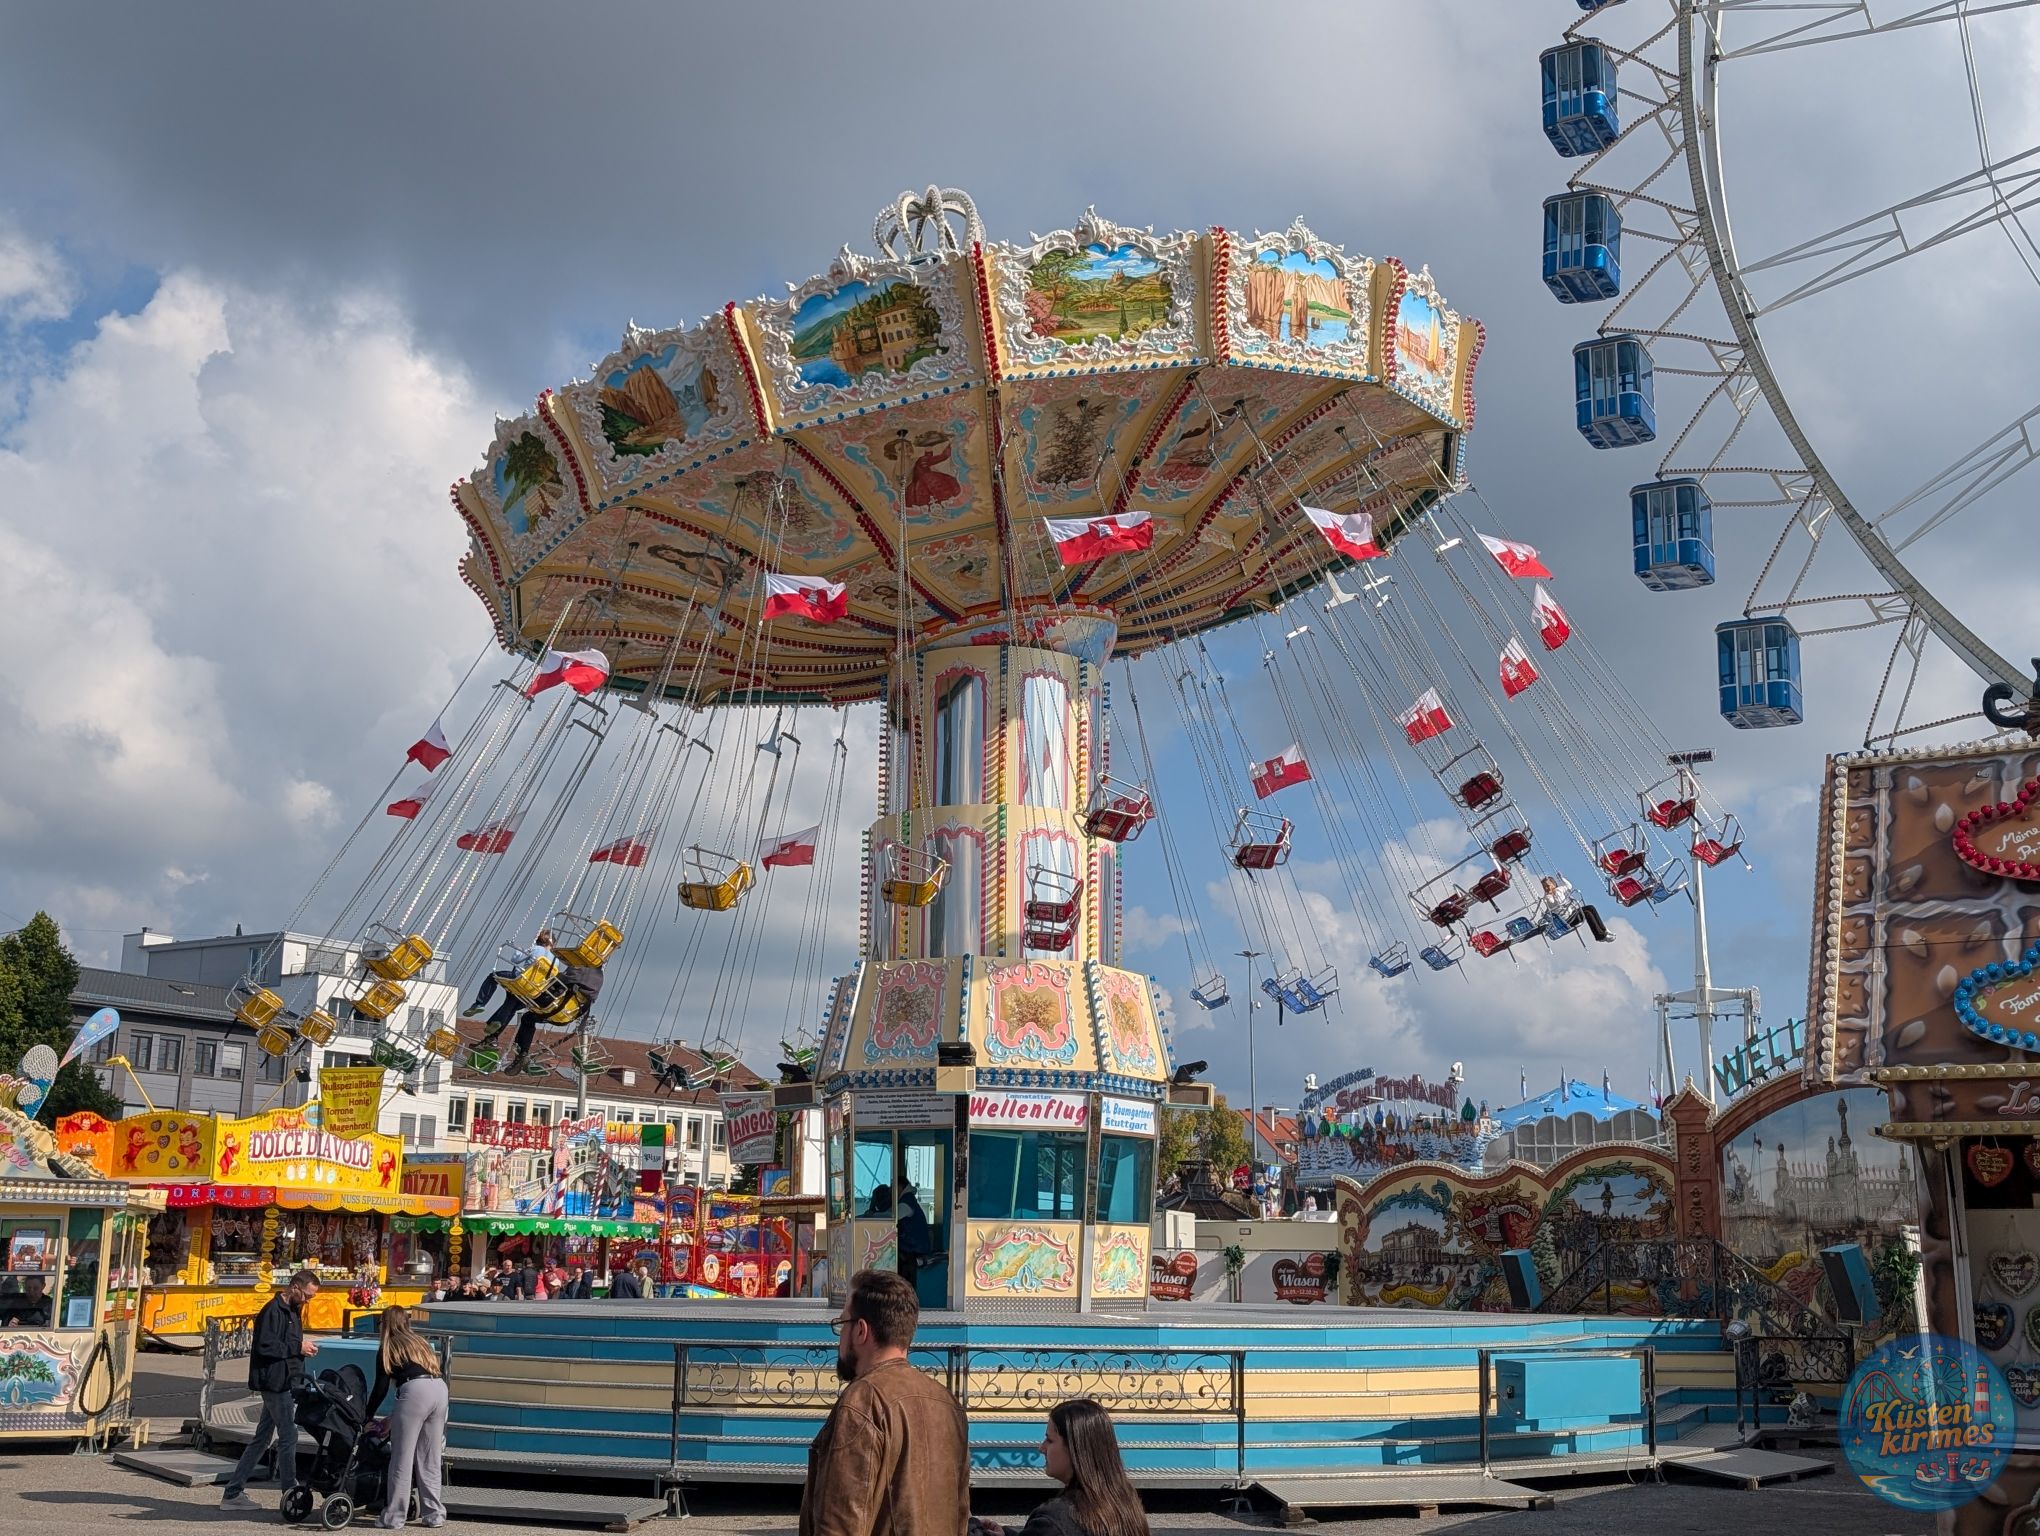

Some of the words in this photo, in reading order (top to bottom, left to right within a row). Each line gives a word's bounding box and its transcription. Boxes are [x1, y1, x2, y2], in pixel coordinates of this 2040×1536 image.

[1996, 827, 2040, 852] Meine
[1999, 987, 2040, 1014] Fam
[1712, 1017, 1805, 1097] WELL
[348, 1096, 372, 1106] Honig!
[325, 1107, 354, 1116] Torrone
[969, 1096, 1088, 1126] Wellenflug
[1112, 1102, 1154, 1121] Baumgartner
[329, 1121, 372, 1132] Magenbrot!
[1104, 1118, 1148, 1131] Stuttgart
[251, 1132, 303, 1159] DOLCE
[307, 1132, 370, 1168] DIAVOLO
[403, 1173, 449, 1197] PIZZA
[173, 1187, 269, 1200] ORRONE
[341, 1194, 361, 1204] NUSS
[394, 1219, 415, 1230] Pizza
[490, 1221, 515, 1230] Pizza
[1151, 1270, 1188, 1286] Wasen
[1279, 1274, 1320, 1287] Wasen
[154, 1311, 188, 1328] SÜSSER
[195, 1295, 226, 1311] TEUFEL
